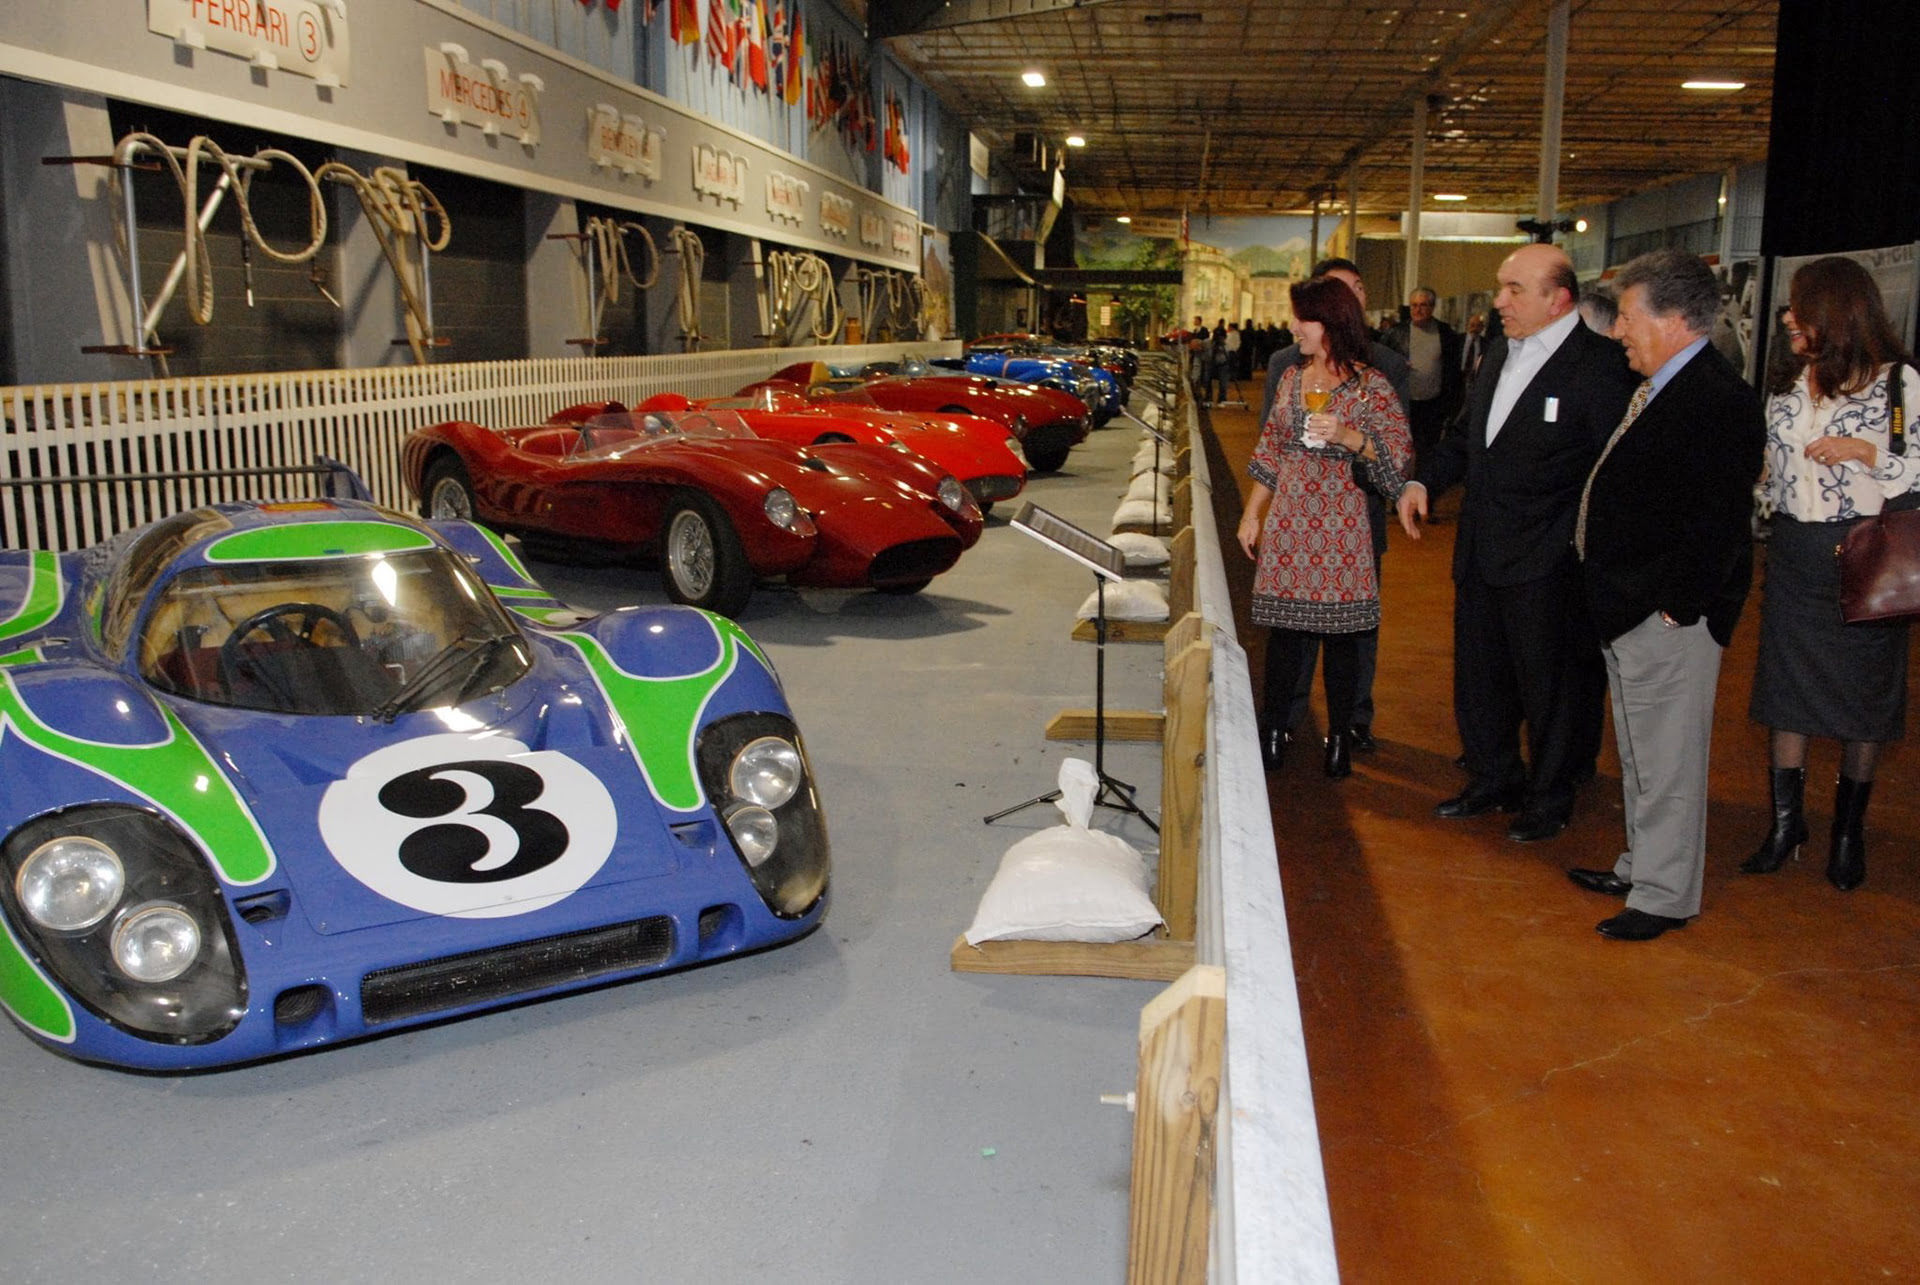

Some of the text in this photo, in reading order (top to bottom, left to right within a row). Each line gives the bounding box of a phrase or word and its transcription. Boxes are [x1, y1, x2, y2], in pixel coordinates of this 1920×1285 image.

[305, 20, 317, 54] 3
[439, 68, 513, 119] MERCEDES
[378, 760, 570, 884] 3
